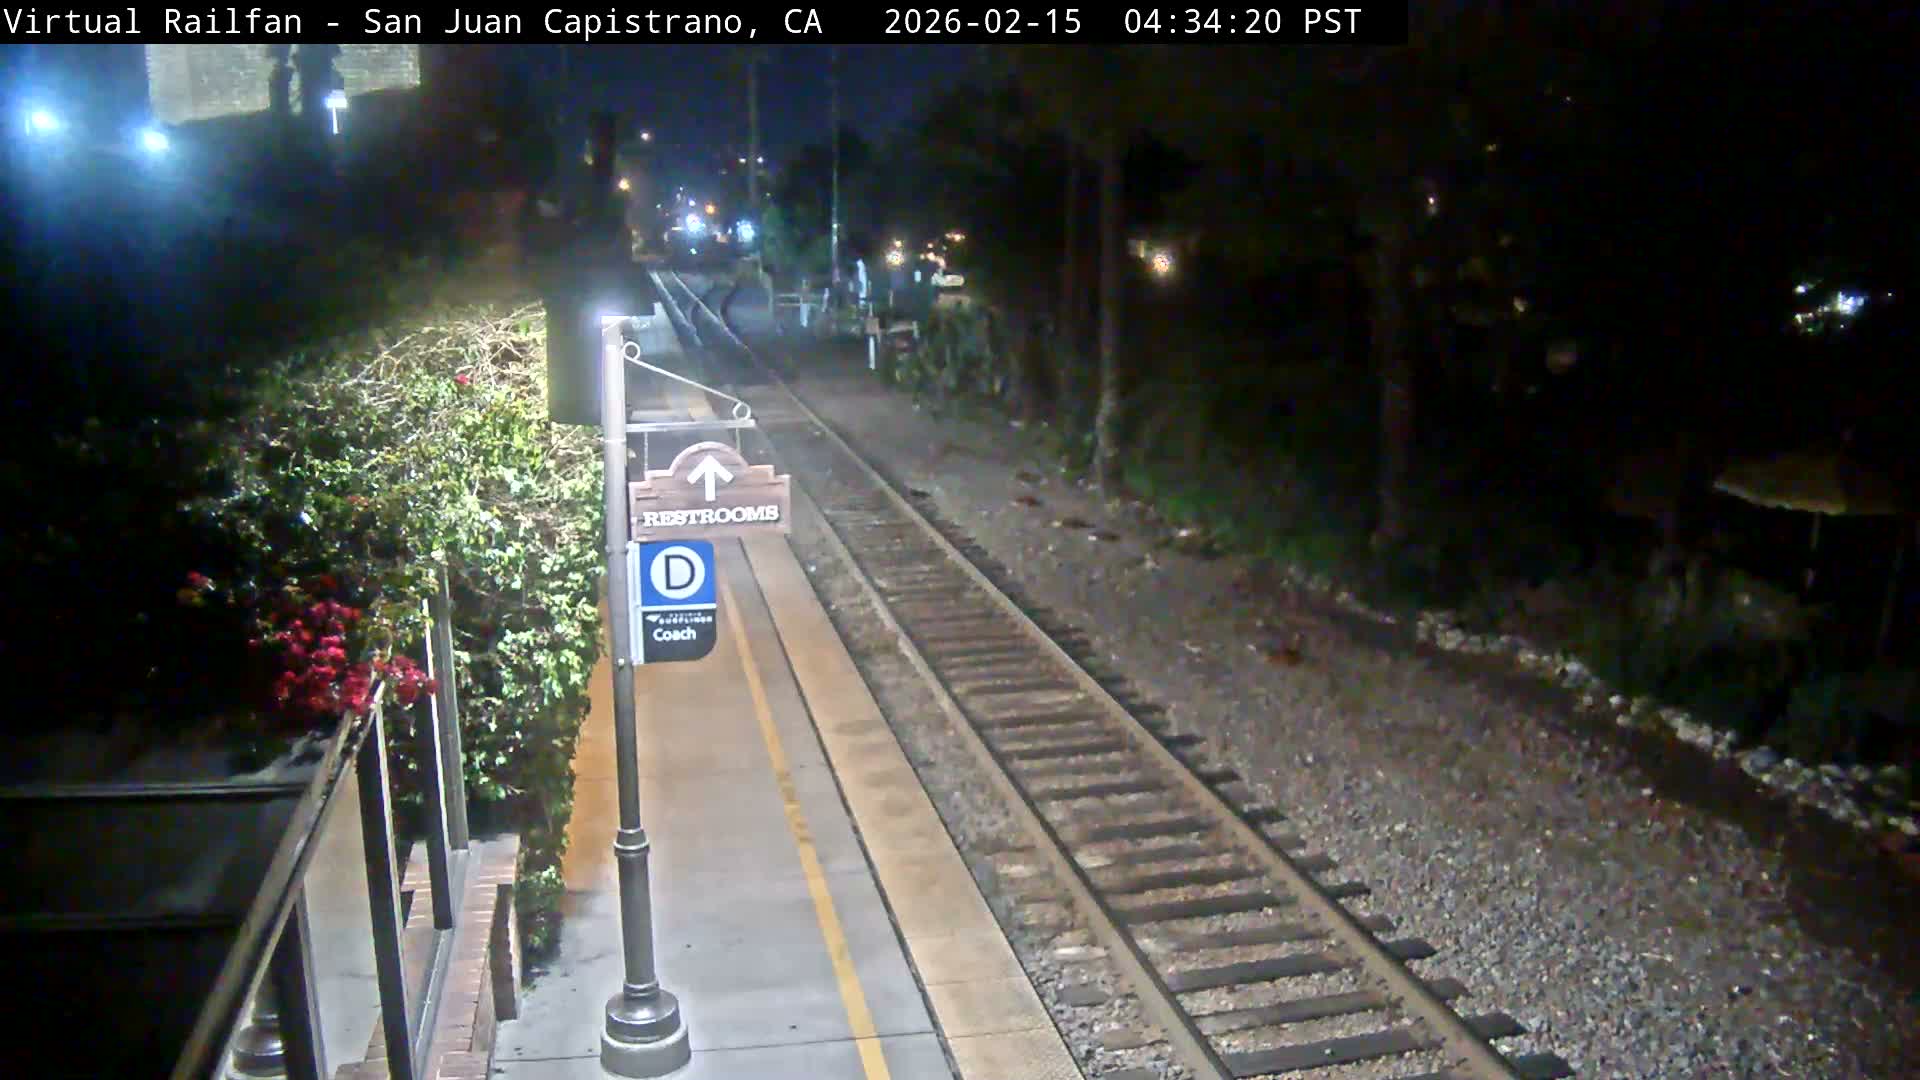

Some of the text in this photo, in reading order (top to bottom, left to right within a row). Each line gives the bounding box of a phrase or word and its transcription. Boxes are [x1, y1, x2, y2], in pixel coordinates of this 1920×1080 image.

[643, 505, 779, 527] RESTROOMS
[664, 554, 695, 590] D
[652, 626, 697, 642] Coach
